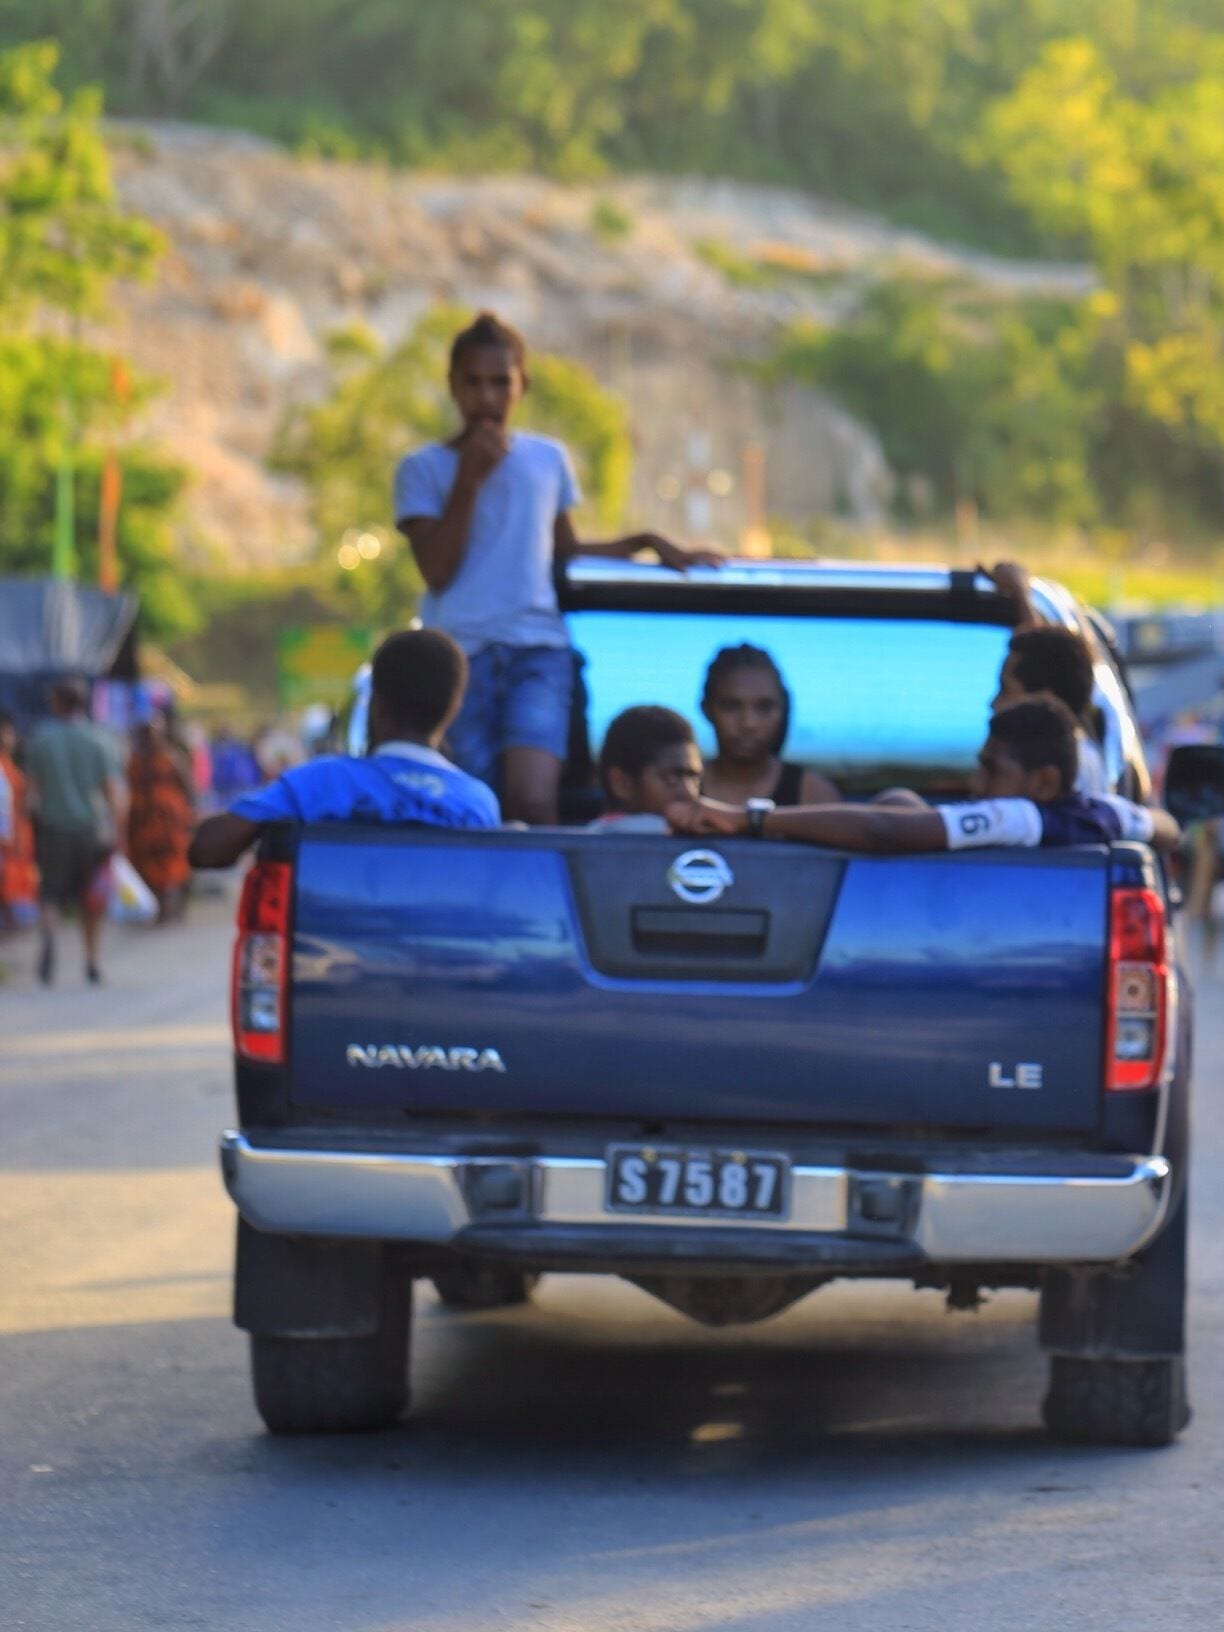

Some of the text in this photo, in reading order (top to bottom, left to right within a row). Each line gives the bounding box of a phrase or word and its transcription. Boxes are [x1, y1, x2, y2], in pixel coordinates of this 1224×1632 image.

[346, 1043, 507, 1073] NAVARA
[989, 1061, 1042, 1089] LE
[618, 1157, 777, 1209] S 7587
